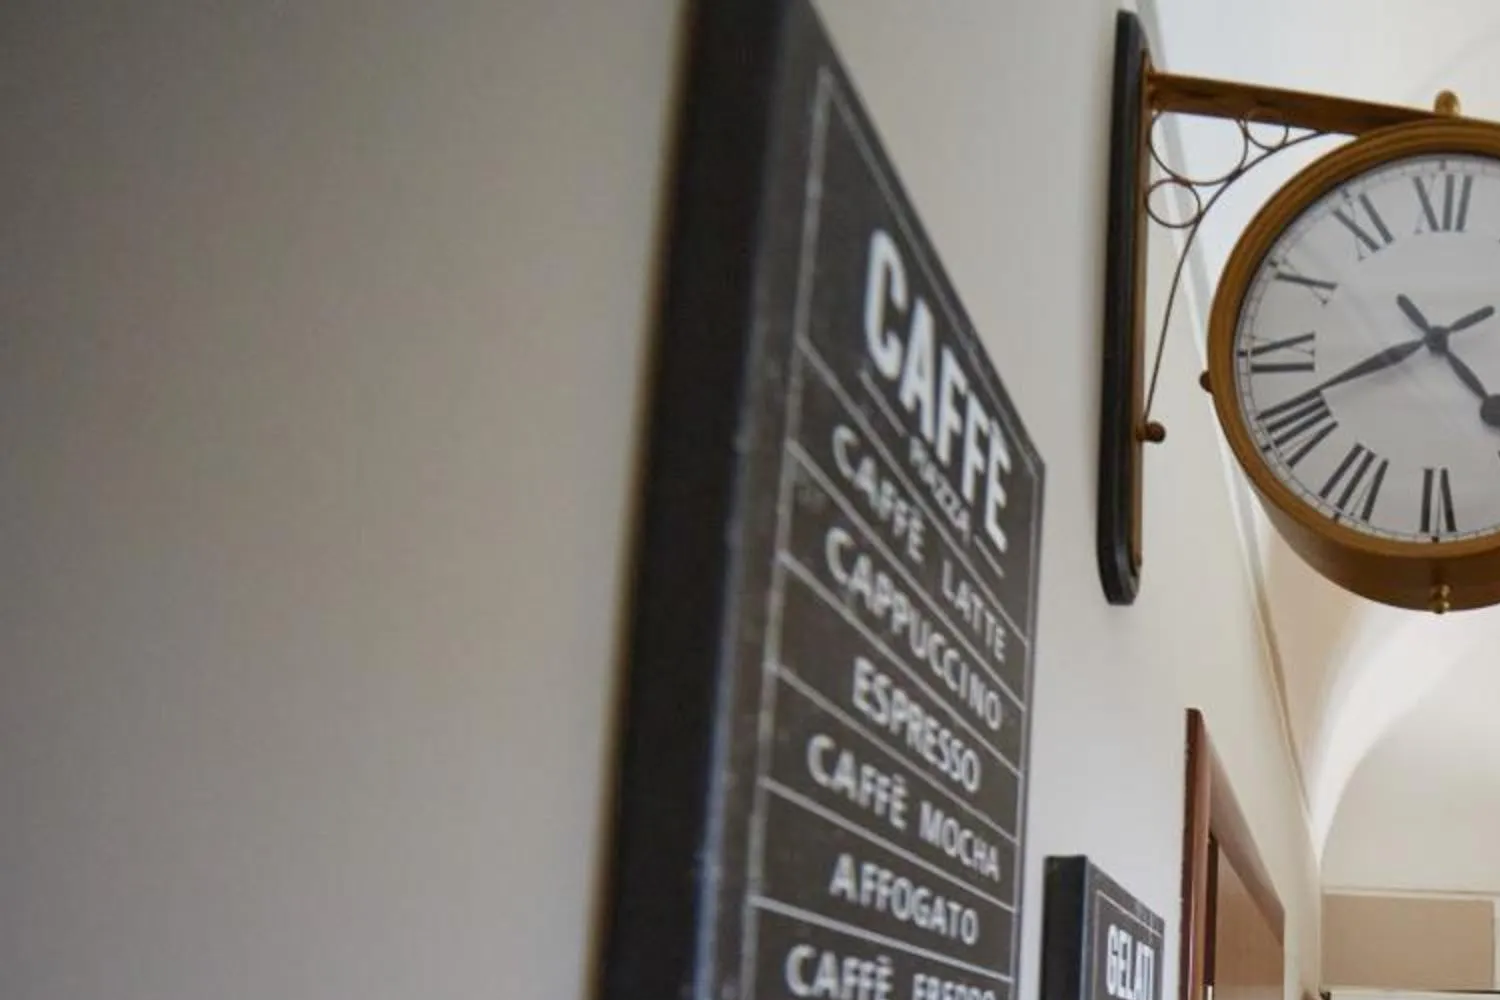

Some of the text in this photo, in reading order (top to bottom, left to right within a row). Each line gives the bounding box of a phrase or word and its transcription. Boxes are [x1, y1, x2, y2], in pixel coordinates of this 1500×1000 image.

[827, 530, 1002, 729] CAPPUCCINO
[942, 561, 1005, 661] LATTE
[854, 659, 980, 791] ESPRESSO
[920, 802, 999, 880] MOCHA
[831, 855, 978, 944] AFFOGATO
